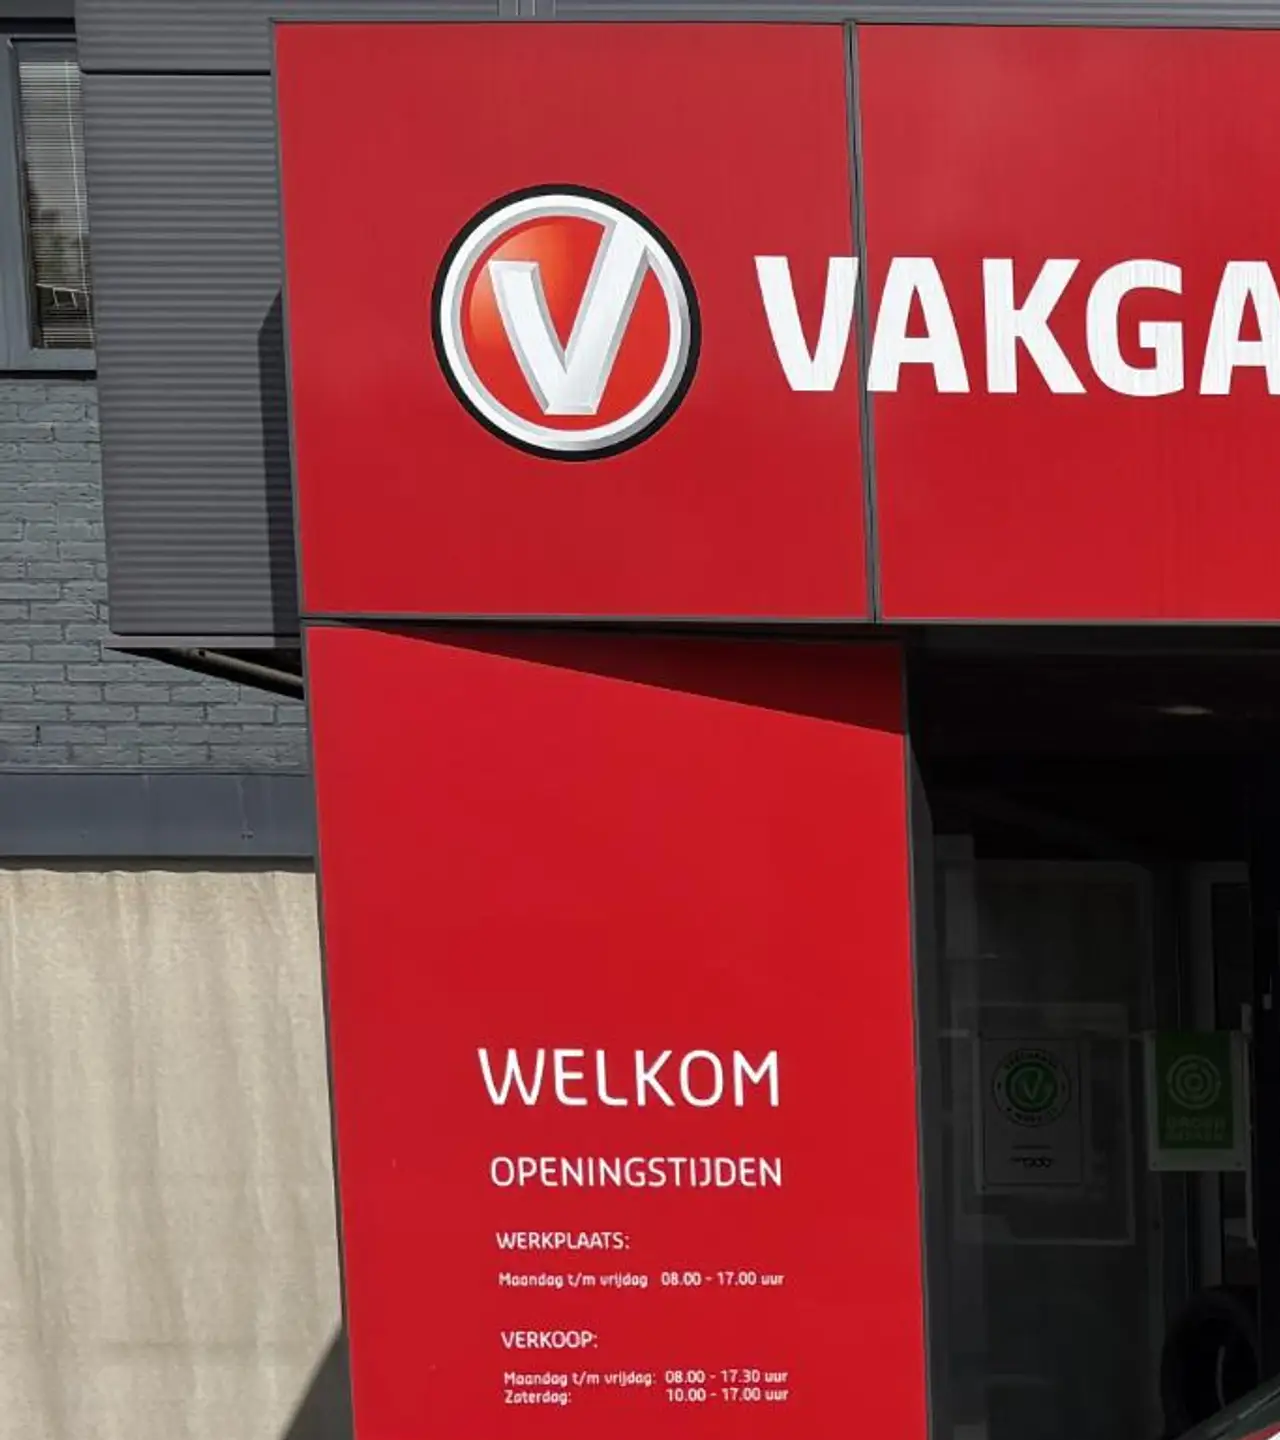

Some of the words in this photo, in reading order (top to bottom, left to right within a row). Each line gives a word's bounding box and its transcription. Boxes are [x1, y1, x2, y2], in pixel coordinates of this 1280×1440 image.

[477, 1048, 780, 1107] WELKOM
[490, 1156, 783, 1187] OPENINGSTIJDEN
[496, 1231, 631, 1250] WERKPLAATS:
[499, 1271, 563, 1287] Maandag
[567, 1271, 596, 1287] t/m
[600, 1271, 648, 1289] vrijdag
[660, 1271, 702, 1286] 08.00
[717, 1271, 757, 1286] 17.00
[761, 1274, 785, 1286] uur
[500, 1331, 598, 1350] VERKOOP:
[504, 1371, 567, 1387] Maandag
[572, 1371, 600, 1387] t/m
[604, 1371, 656, 1388] vrijdag:
[665, 1370, 706, 1385] 08.00
[720, 1369, 760, 1384] 17.30
[765, 1372, 788, 1384] uur
[504, 1389, 572, 1406] Zaterdag:
[666, 1388, 706, 1403] 10.00
[723, 1387, 761, 1402] 17.00
[765, 1389, 789, 1402] uur
